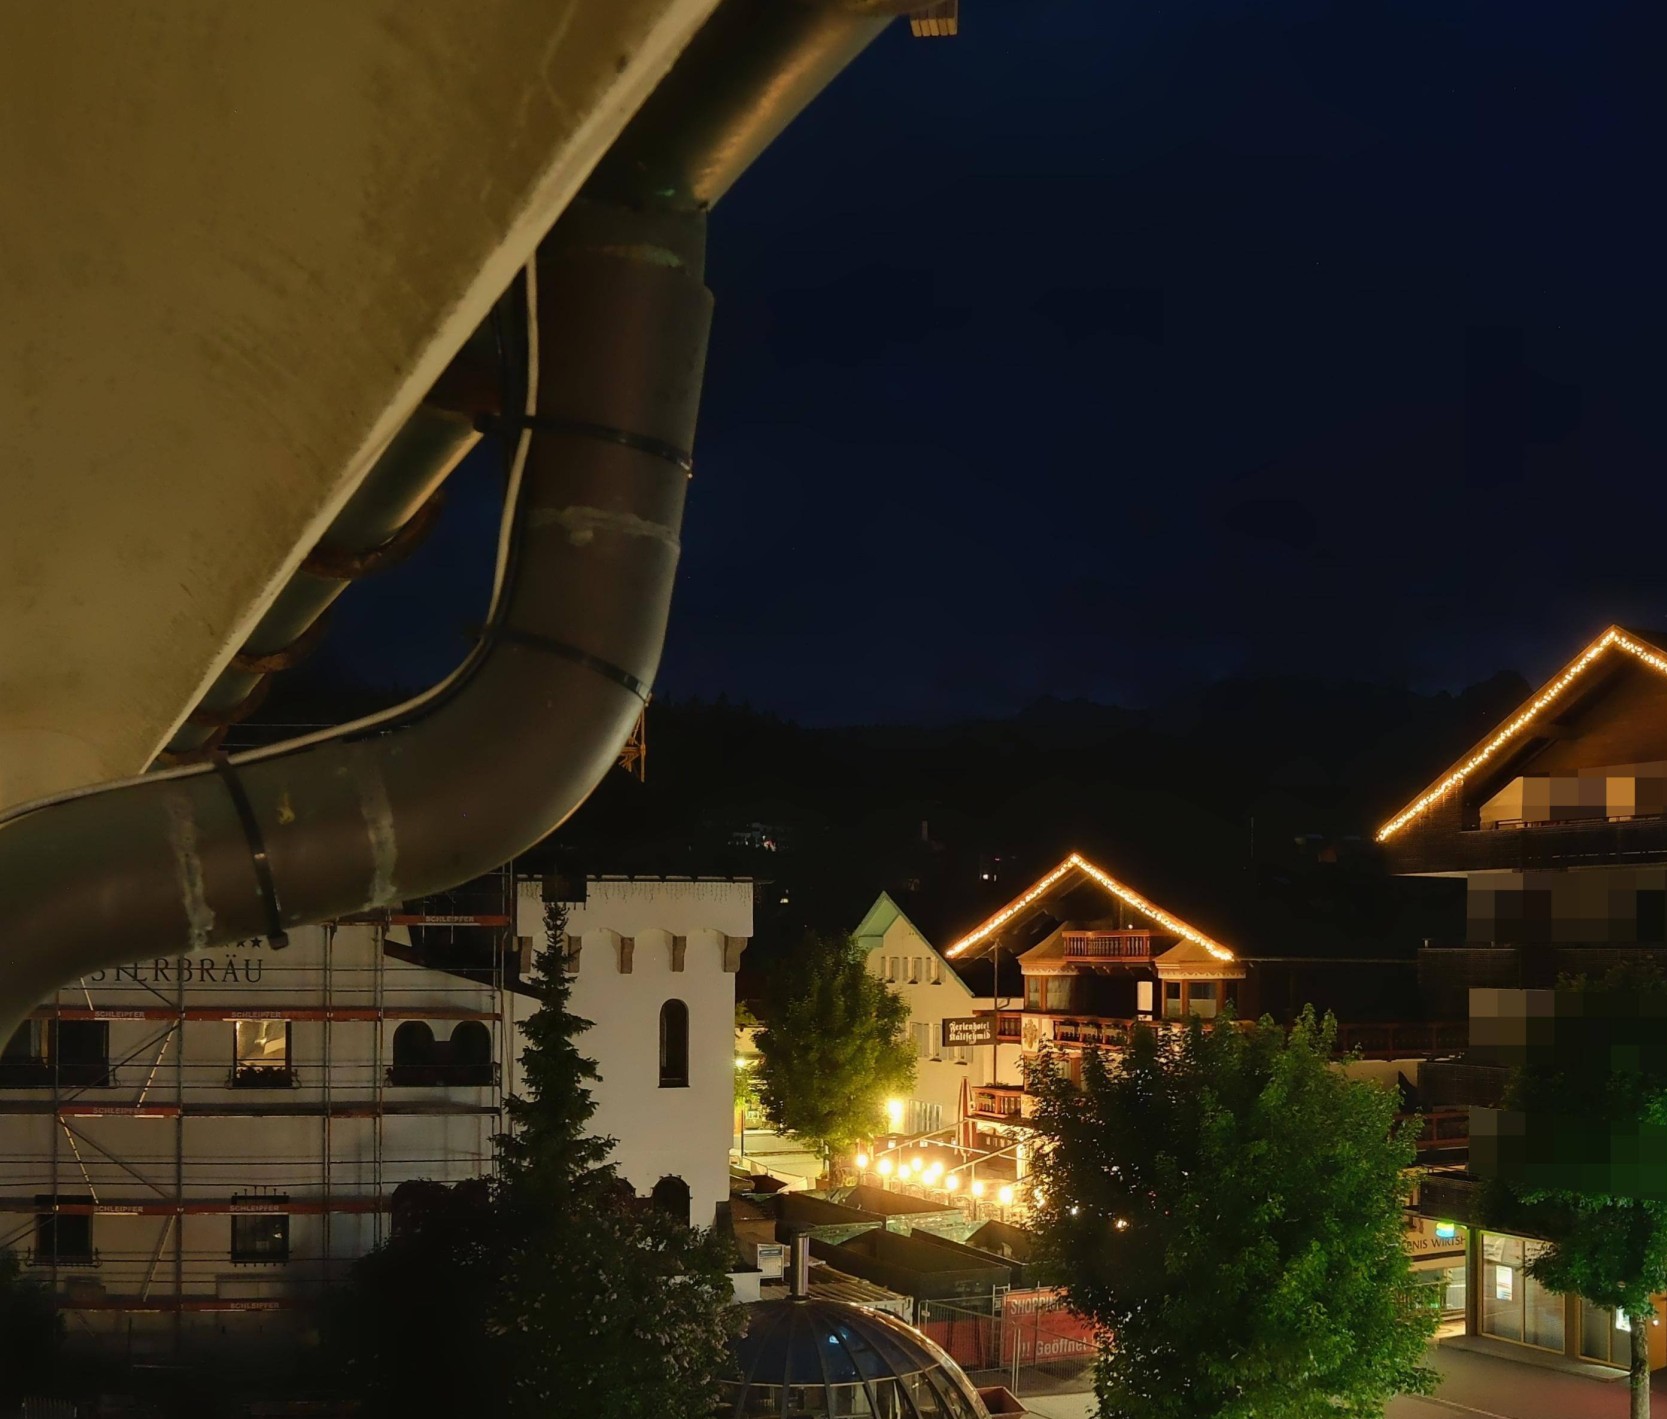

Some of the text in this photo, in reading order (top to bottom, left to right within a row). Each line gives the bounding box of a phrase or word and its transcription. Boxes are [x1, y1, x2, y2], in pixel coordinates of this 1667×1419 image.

[425, 915, 475, 923] SCHLEIPFER
[94, 1205, 143, 1213] SCHLEIPFER
[1036, 1337, 1087, 1356] Geöffnet
